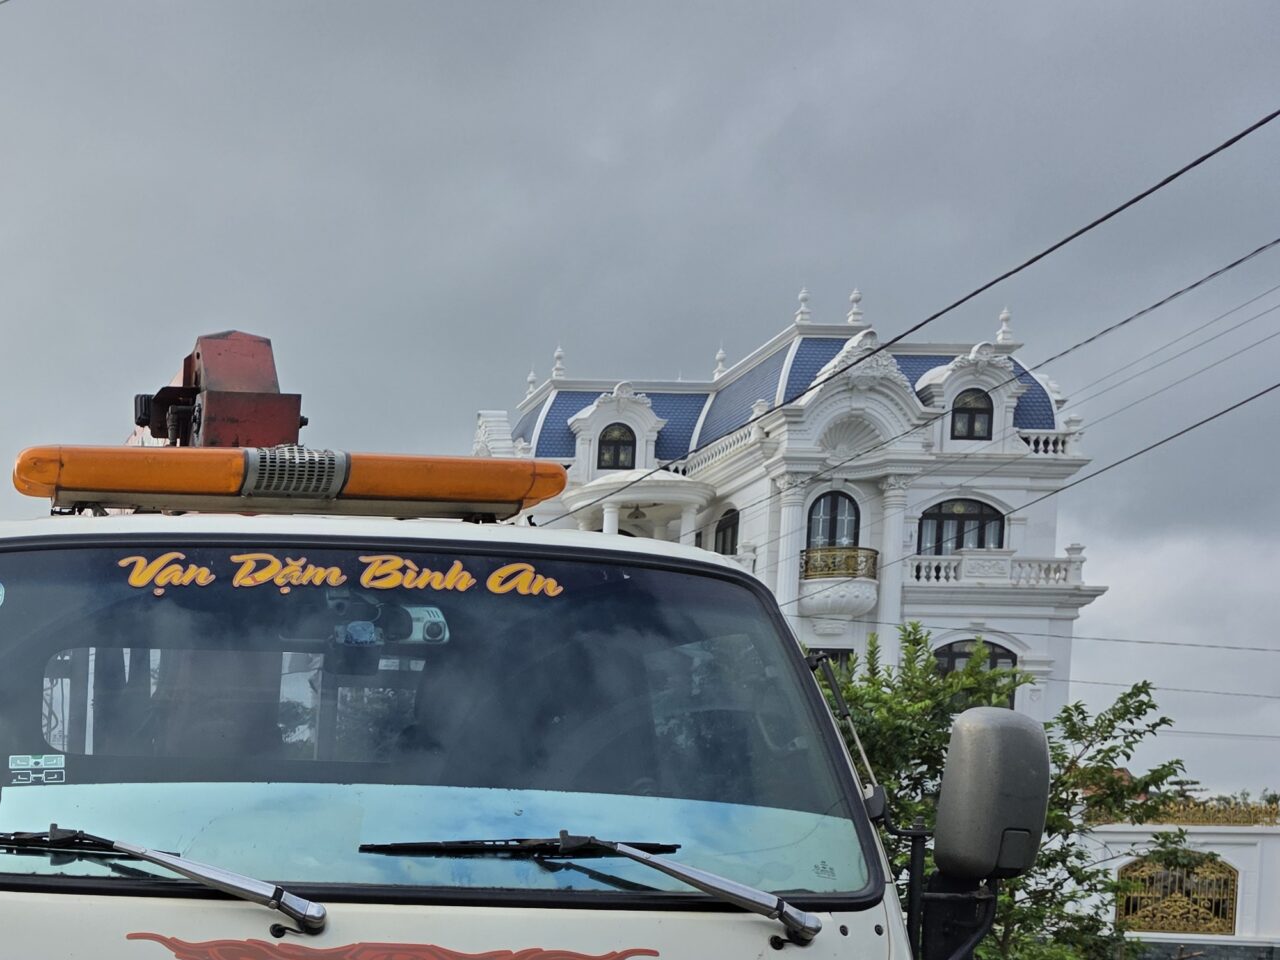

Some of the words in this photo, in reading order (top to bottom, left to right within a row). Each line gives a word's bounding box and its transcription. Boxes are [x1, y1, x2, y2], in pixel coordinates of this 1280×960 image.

[118, 552, 216, 596] Vạn
[230, 553, 347, 594] Dặm
[358, 554, 477, 592] Bình
[486, 562, 564, 597] An
